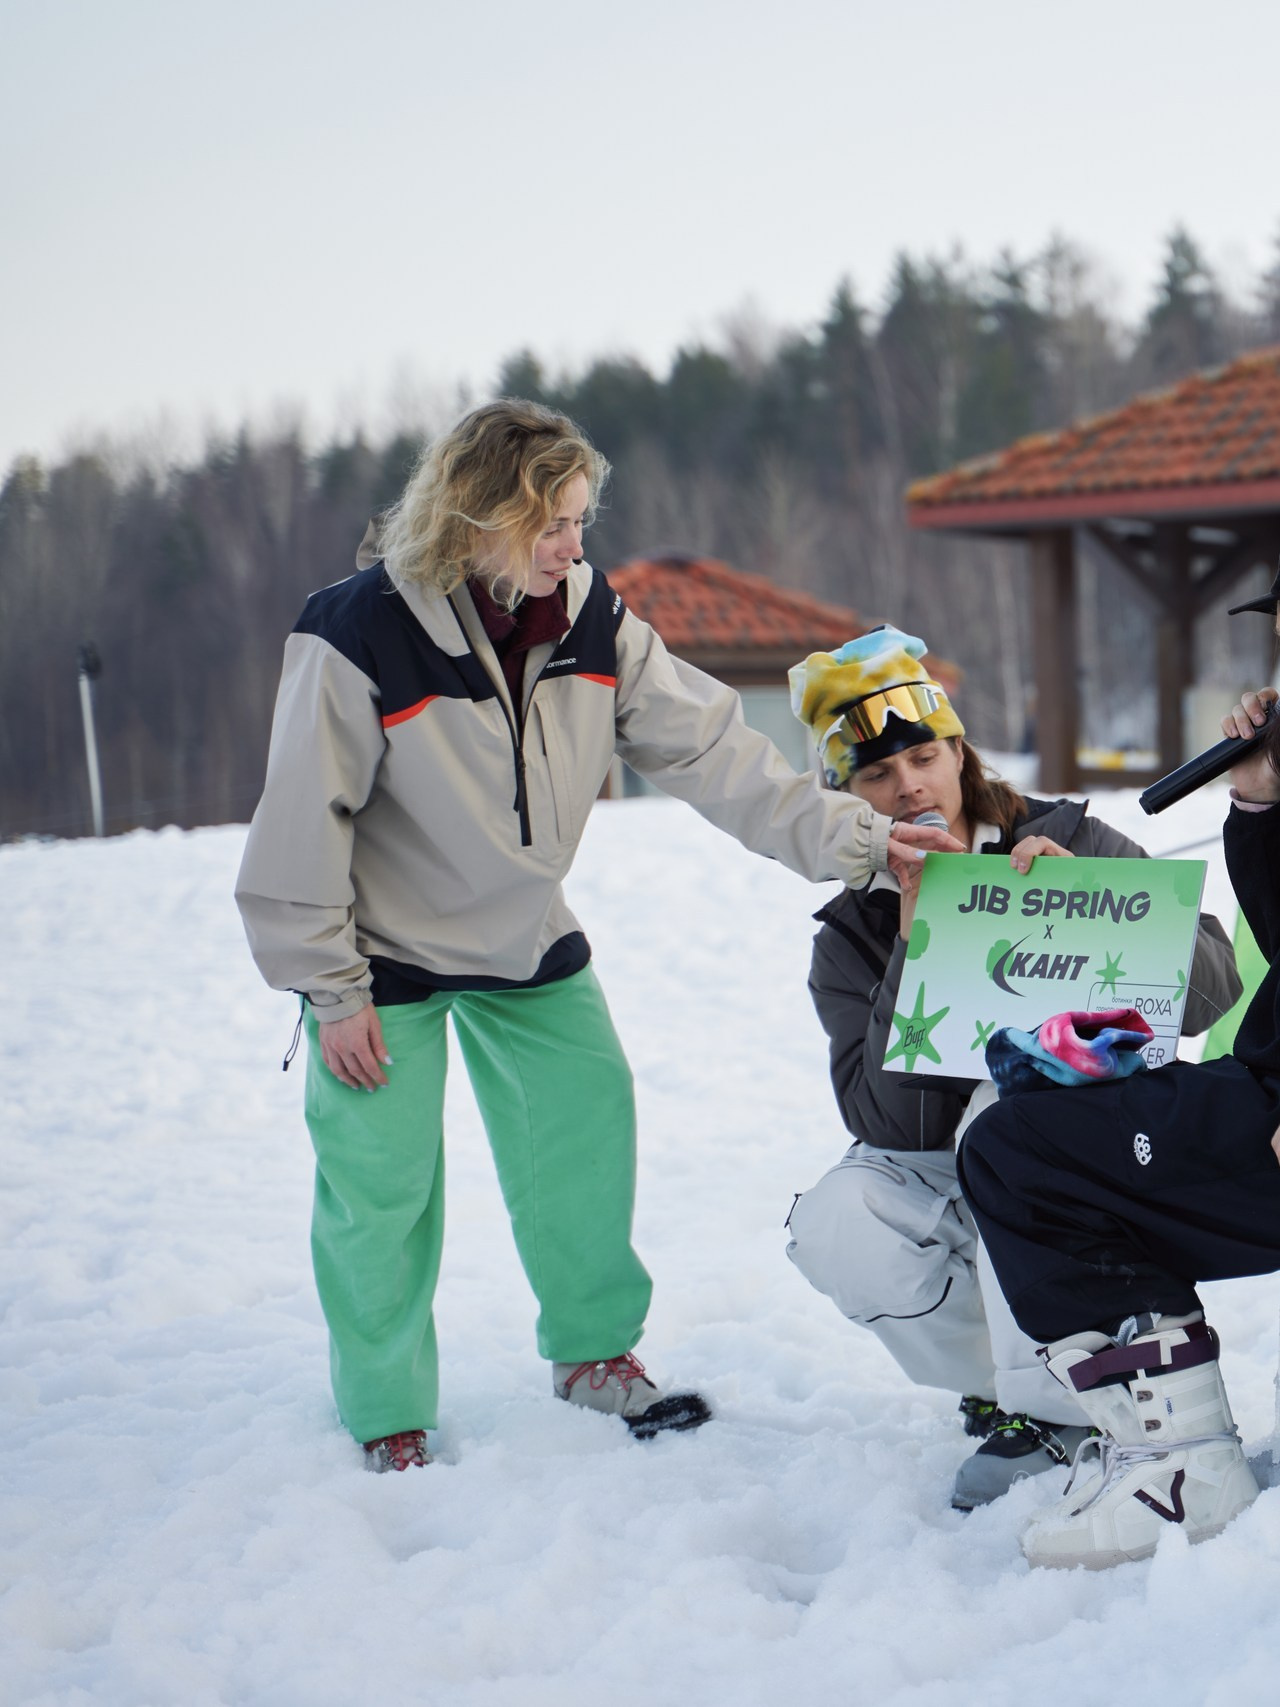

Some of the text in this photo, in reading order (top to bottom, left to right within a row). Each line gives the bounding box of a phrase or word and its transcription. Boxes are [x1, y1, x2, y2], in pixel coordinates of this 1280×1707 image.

[958, 884, 1151, 924] JIB SPRING
[1134, 997, 1172, 1017] ROXA
